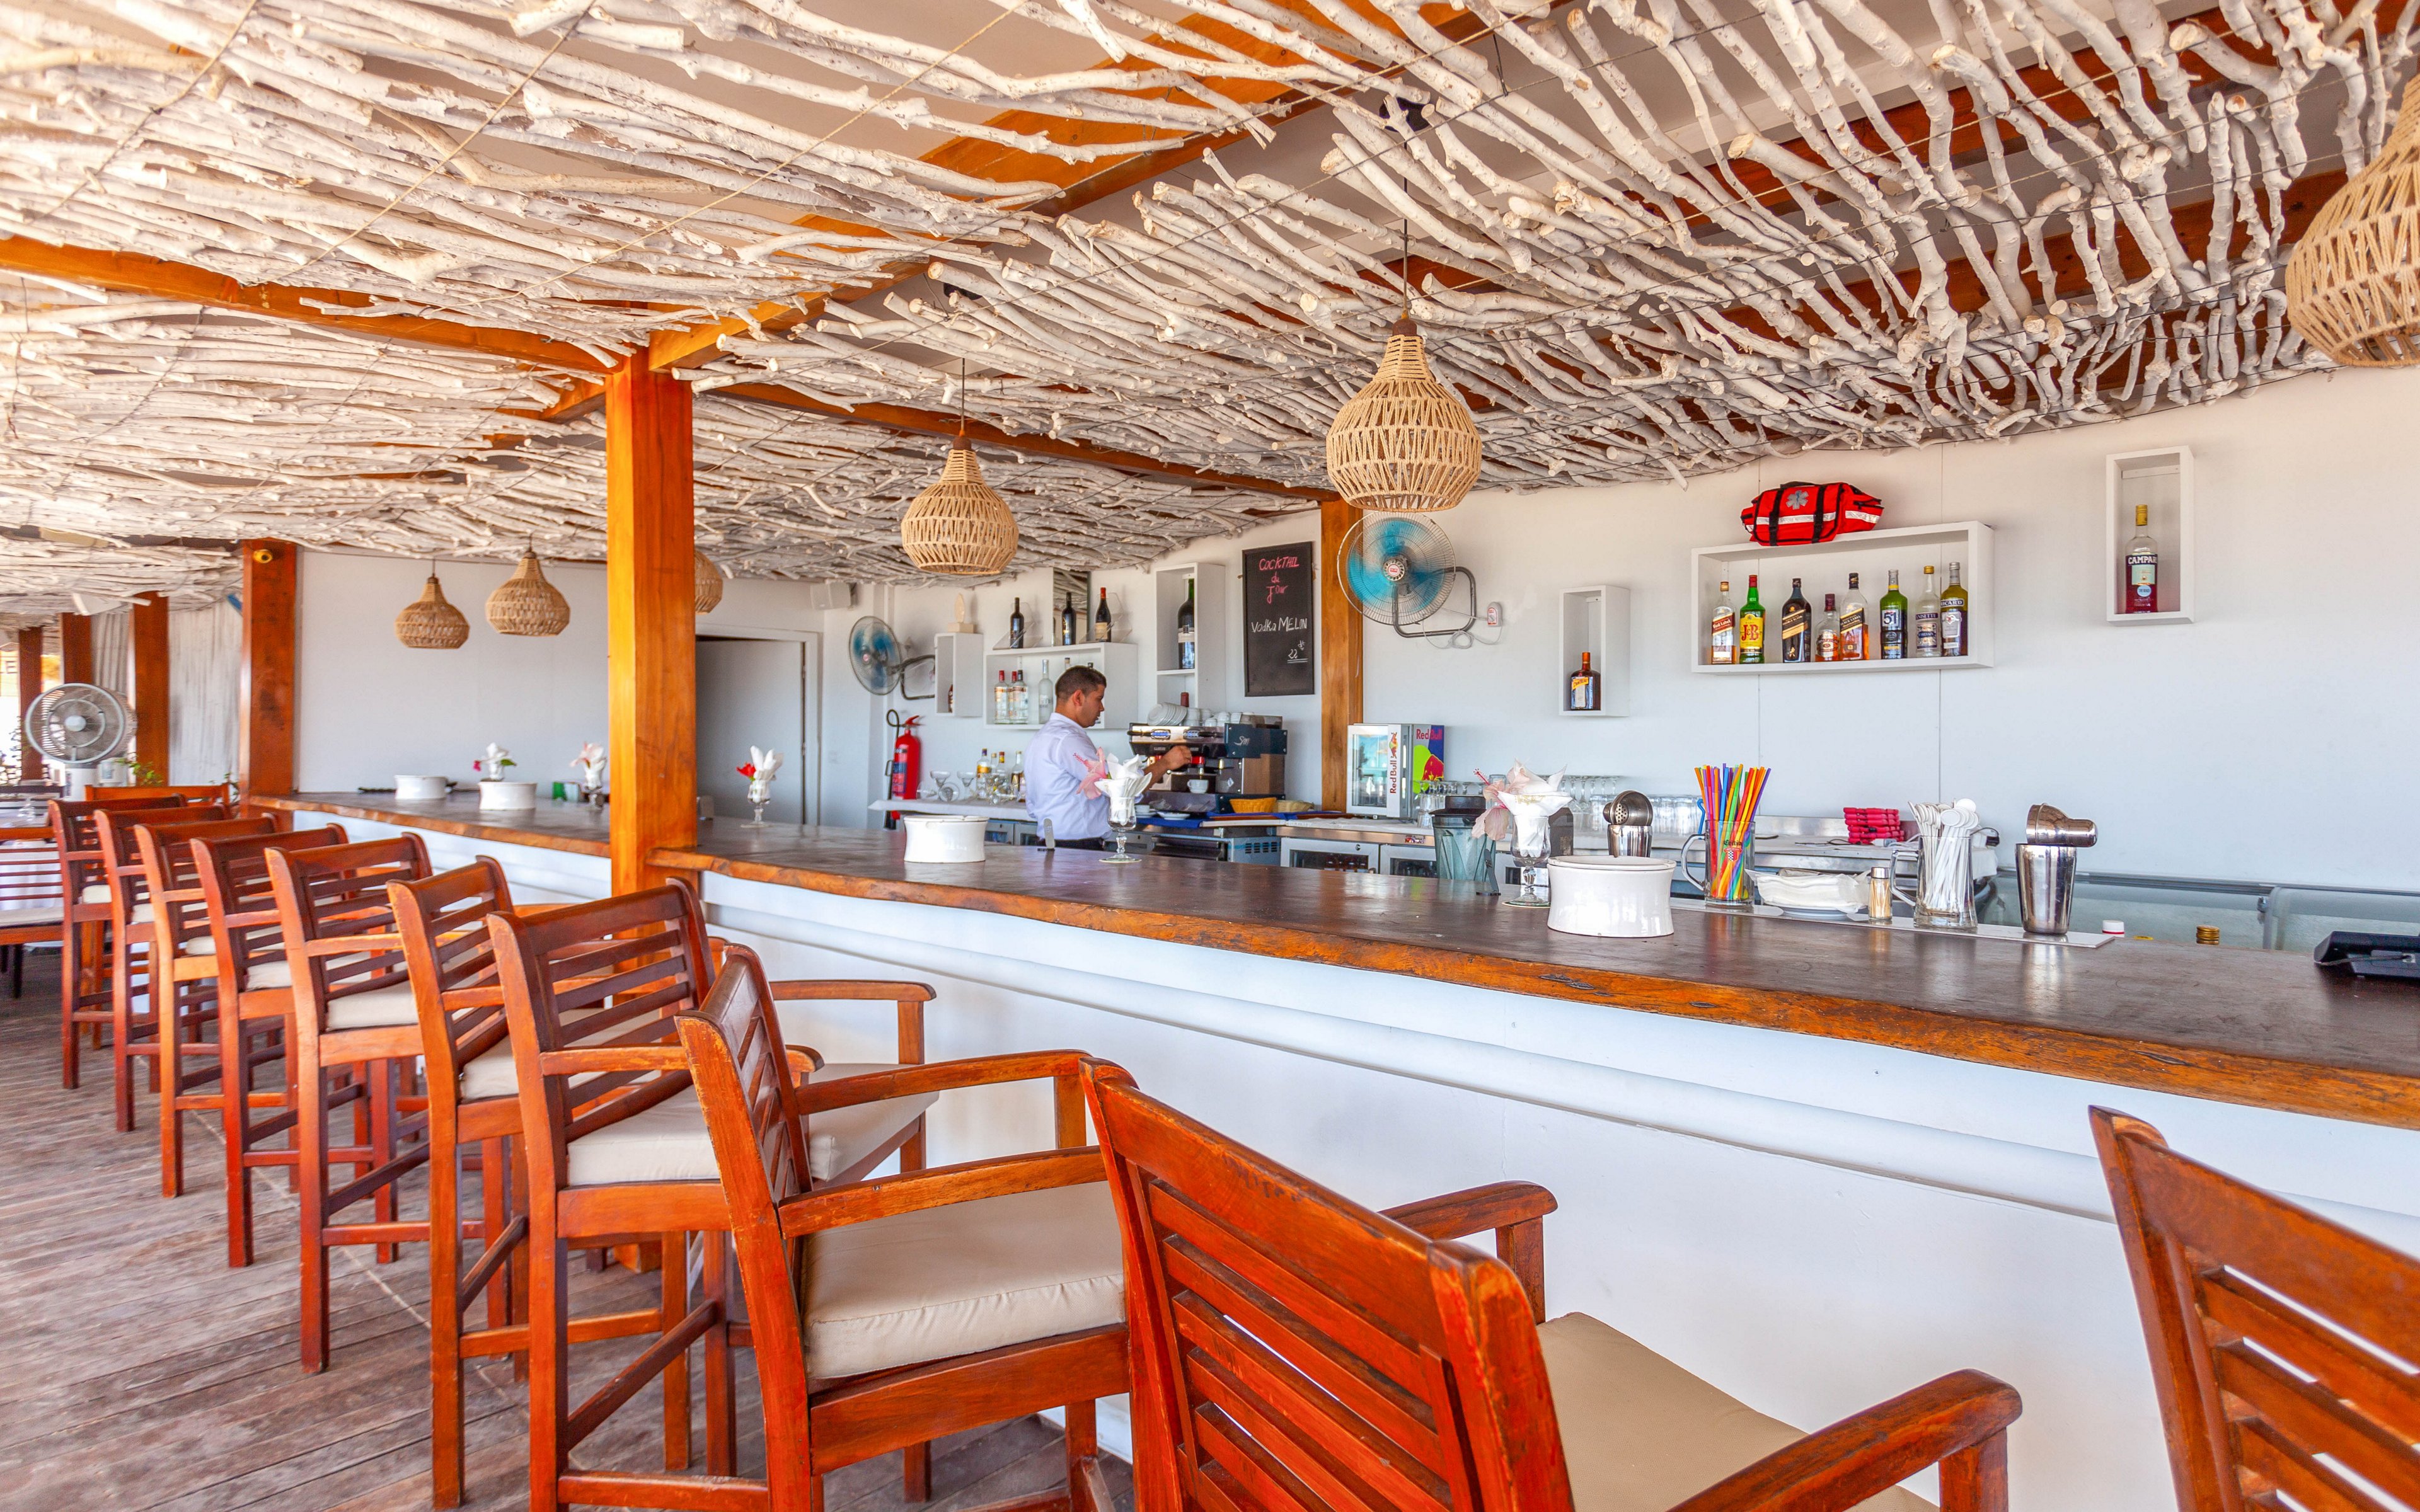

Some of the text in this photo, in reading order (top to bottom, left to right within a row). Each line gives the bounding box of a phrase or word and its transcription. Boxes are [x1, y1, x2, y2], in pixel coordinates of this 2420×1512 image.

[2128, 556, 2157, 564] CAMPAR
[1270, 571, 1280, 583] du
[1883, 612, 1897, 624] 51
[1741, 624, 1759, 641] J&B
[1416, 729, 1443, 740] Red Bull
